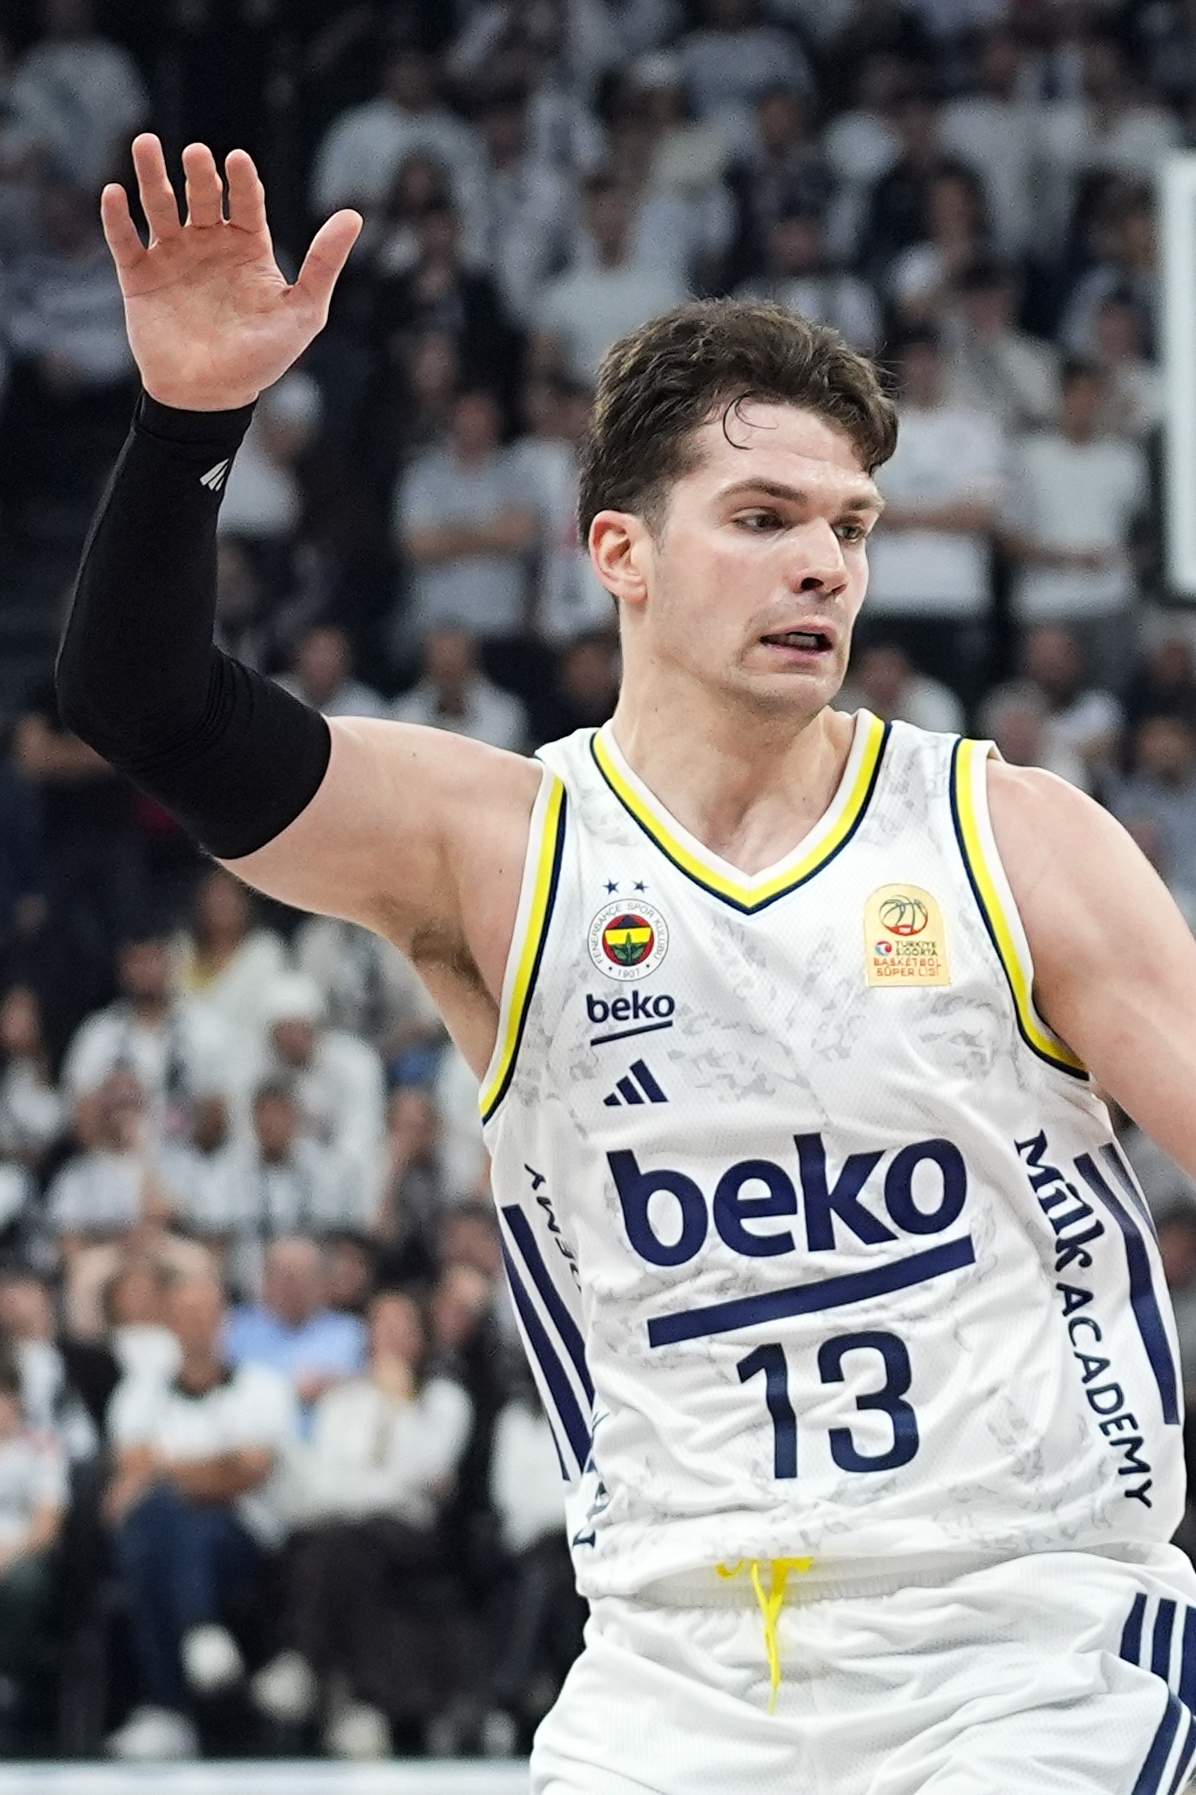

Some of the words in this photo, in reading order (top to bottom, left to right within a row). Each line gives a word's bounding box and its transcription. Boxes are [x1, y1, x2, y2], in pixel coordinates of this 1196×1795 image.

[627, 902, 655, 918] SPOR
[586, 990, 675, 1024] beko
[605, 1133, 968, 1268] beko
[1014, 1129, 1106, 1272] Milk
[735, 1330, 920, 1480] 13
[1055, 1282, 1153, 1509] ACADEMY
